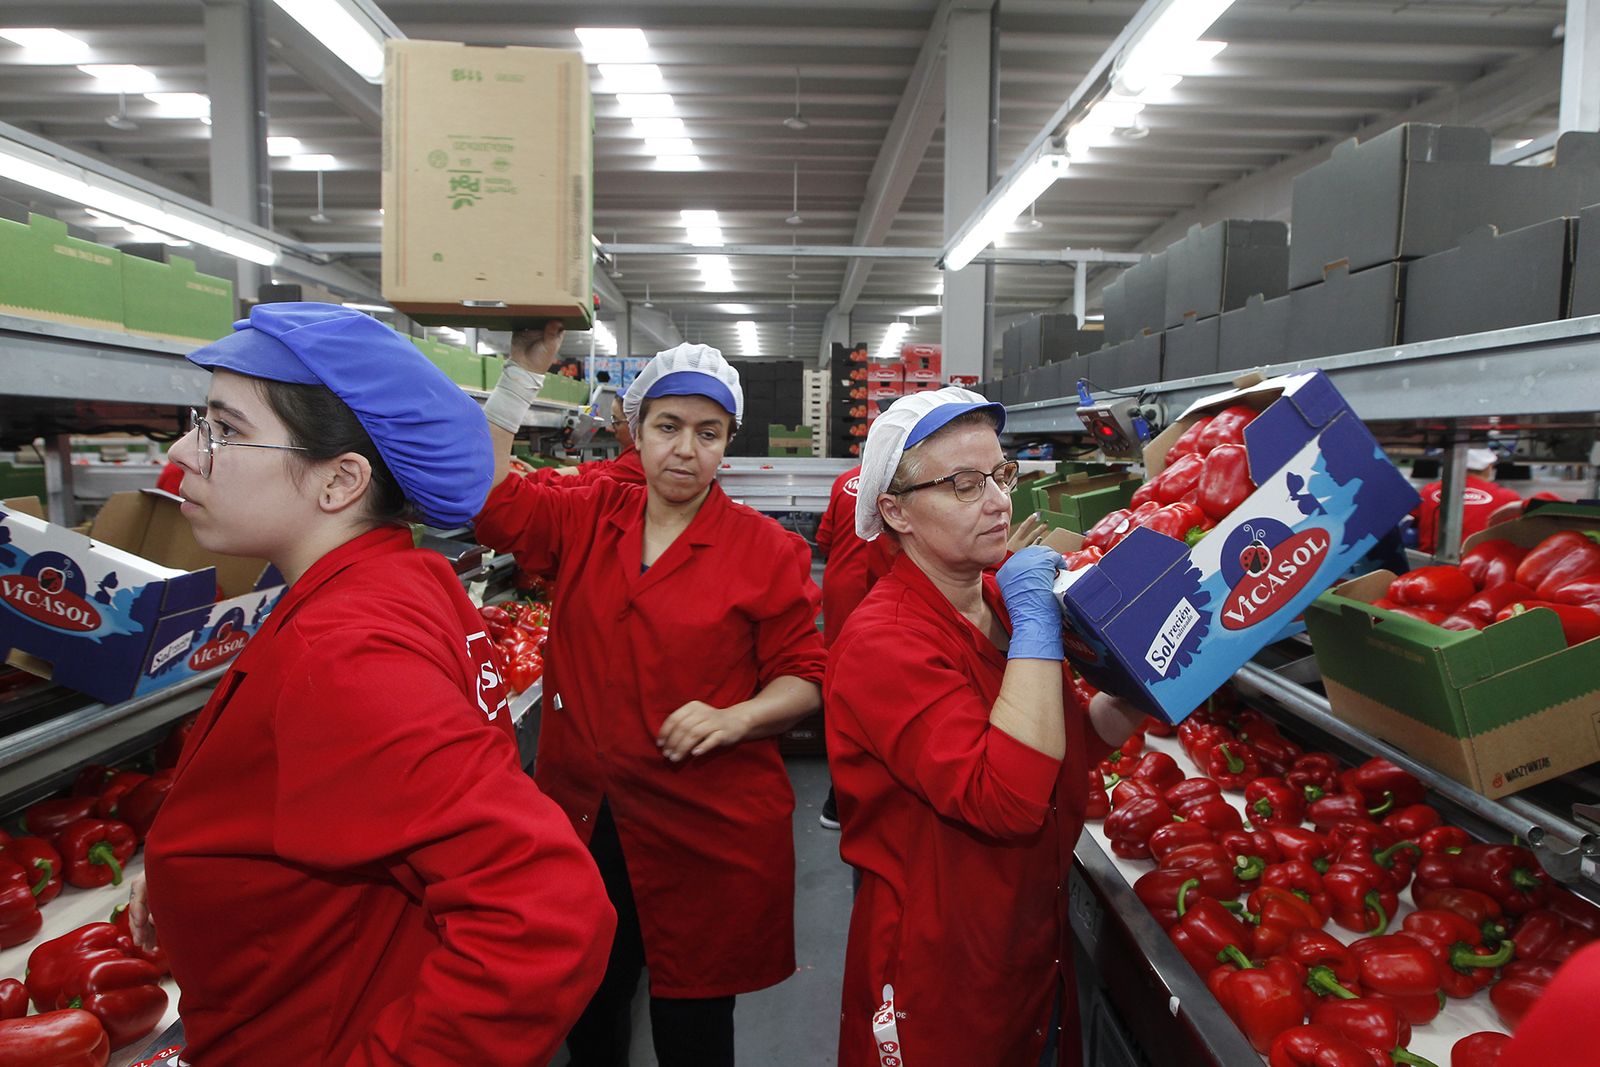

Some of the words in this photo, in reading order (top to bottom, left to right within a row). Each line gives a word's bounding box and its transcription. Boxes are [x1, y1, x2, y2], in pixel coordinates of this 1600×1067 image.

[1151, 632, 1176, 669] Sol
[1168, 606, 1191, 637] recién
[896, 1011, 907, 1019] 30
[883, 1043, 894, 1052] 30
[886, 1057, 897, 1066] 30
